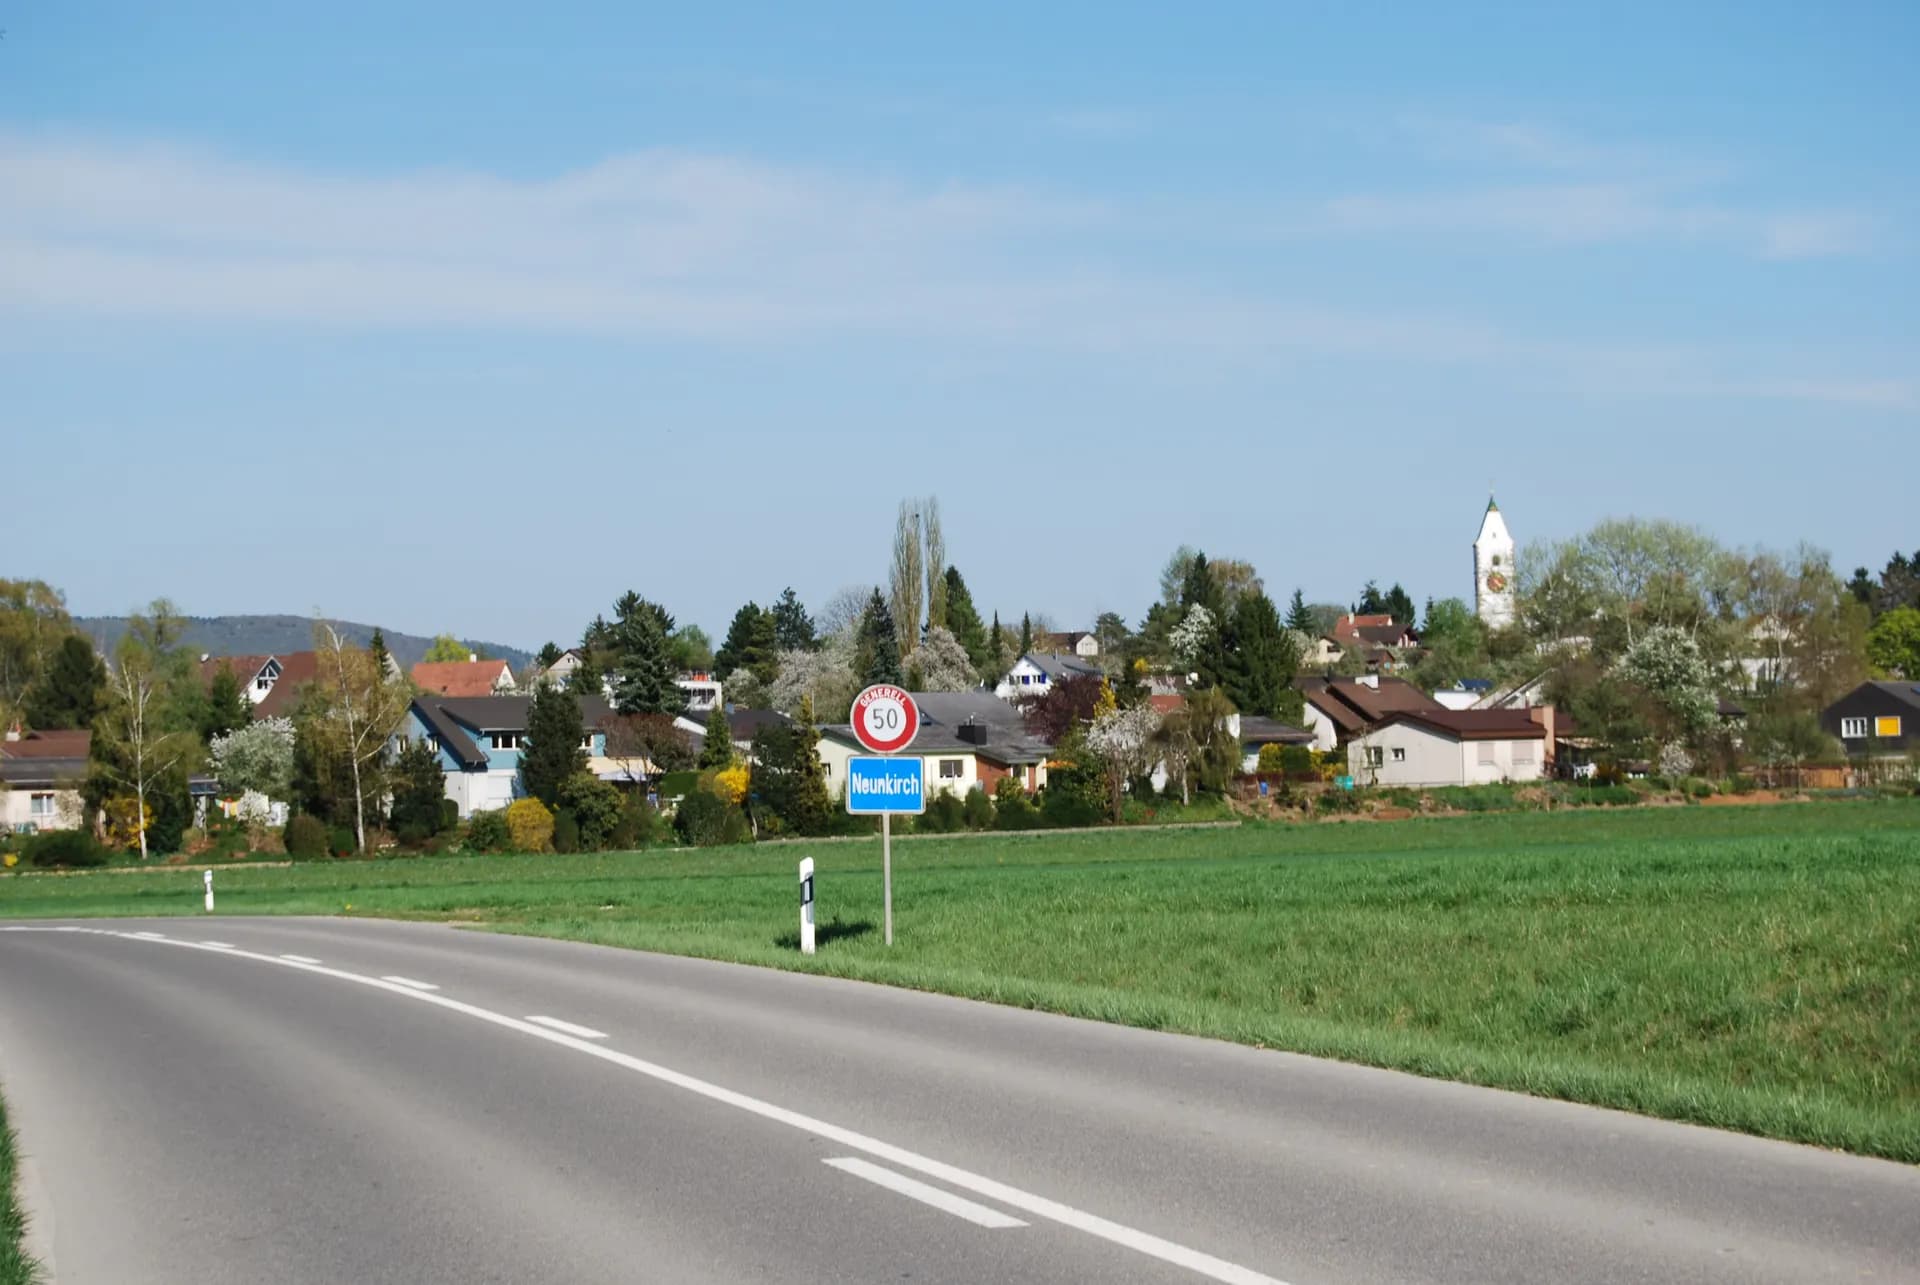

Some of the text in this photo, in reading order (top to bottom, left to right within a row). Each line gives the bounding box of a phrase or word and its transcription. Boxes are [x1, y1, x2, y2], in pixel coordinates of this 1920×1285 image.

[860, 688, 906, 708] GENERELL
[873, 708, 898, 729] 50
[852, 772, 919, 795] Neunkirch
